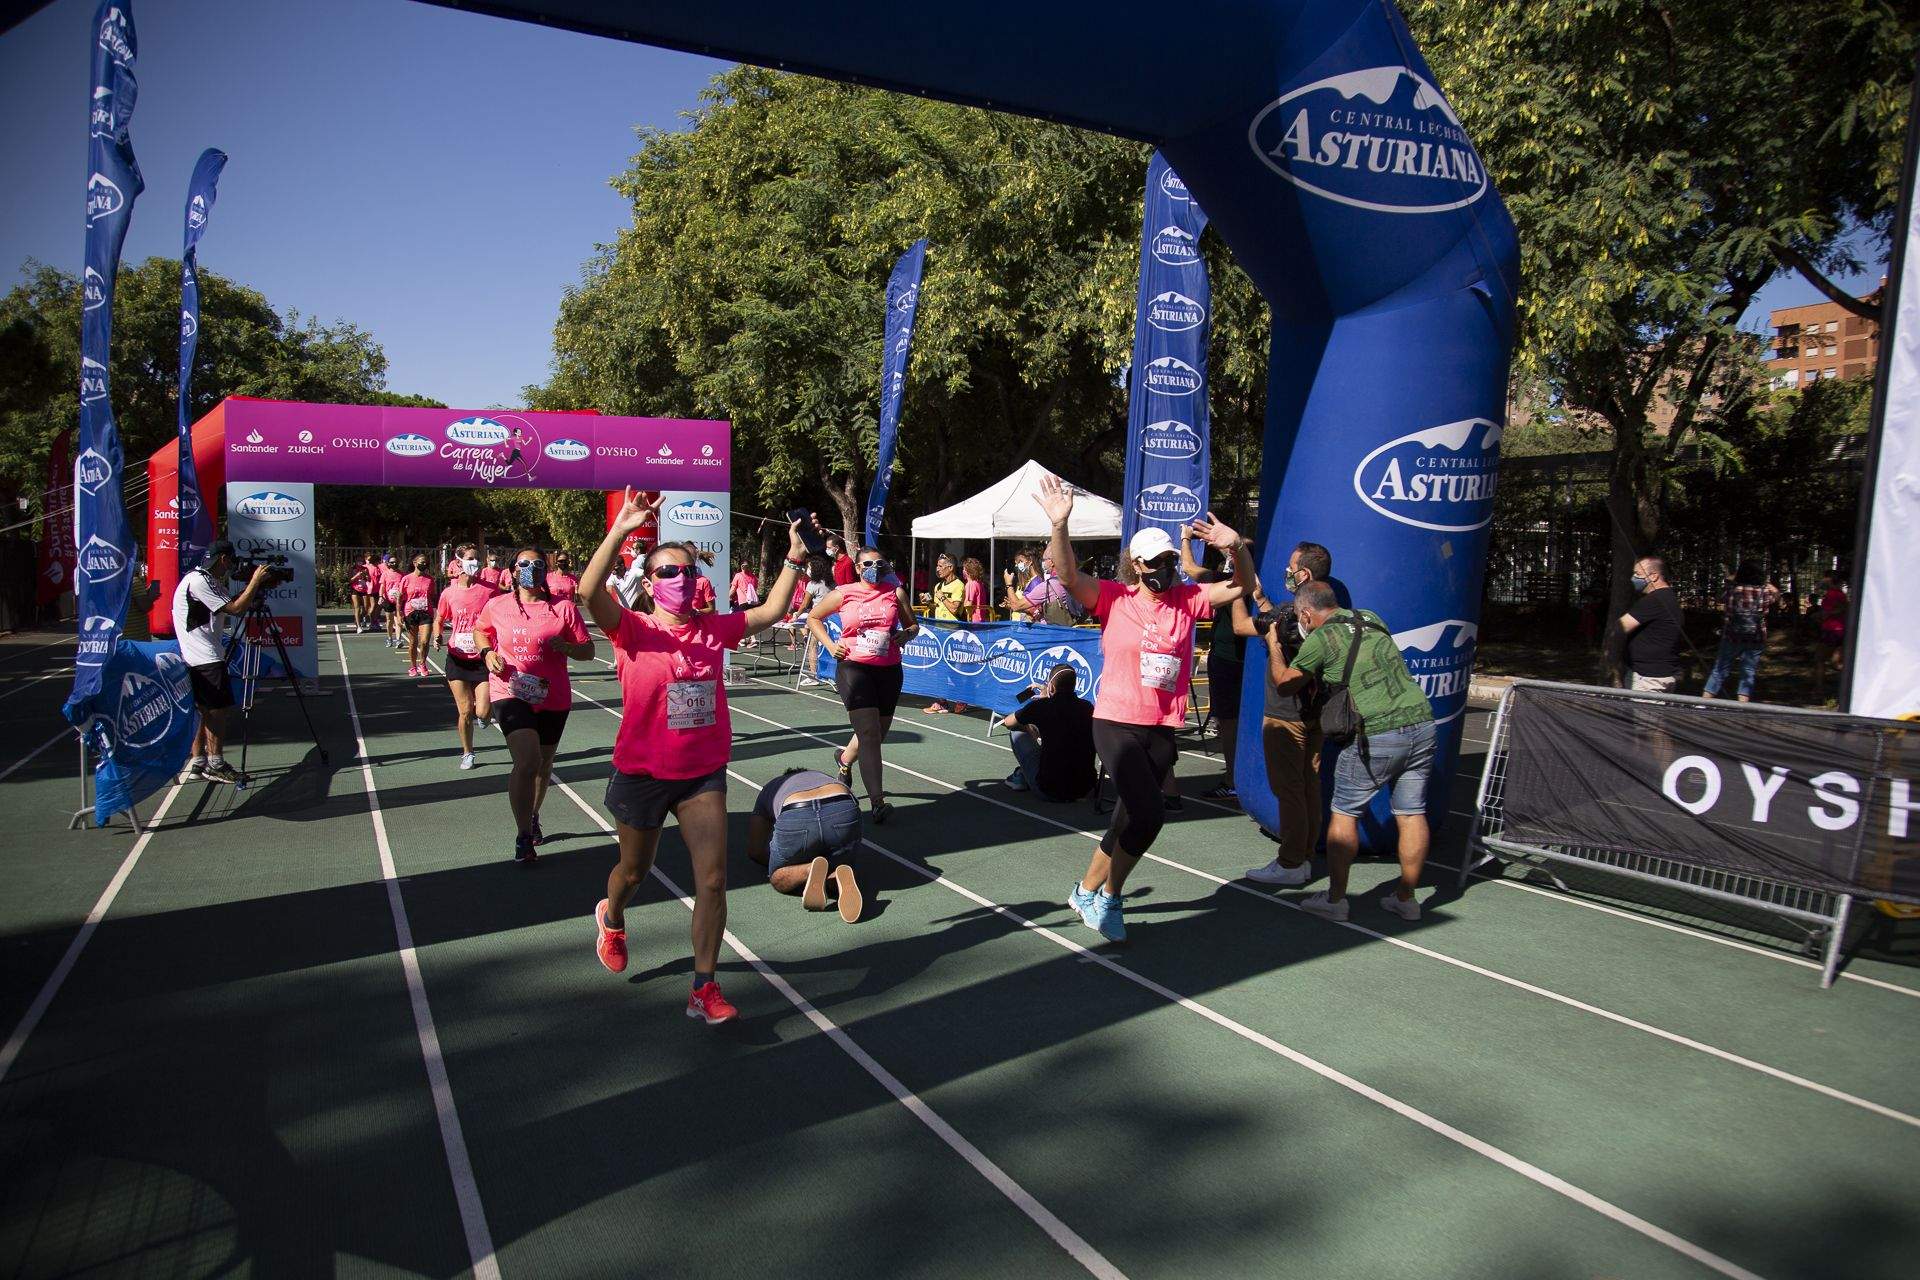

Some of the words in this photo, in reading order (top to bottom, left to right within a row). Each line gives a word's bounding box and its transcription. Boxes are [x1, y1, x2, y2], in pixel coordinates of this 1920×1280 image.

[1330, 109, 1412, 132] CENTRAL
[1269, 108, 1482, 185] ASTURIANA
[1144, 369, 1196, 389] ASTURIANA
[450, 426, 506, 440] ASTURIANA
[230, 443, 279, 453] Santander
[332, 437, 380, 449] OYSHO
[389, 442, 432, 452] ASTURIANA
[288, 445, 324, 454] ZURICH
[440, 442, 493, 460] Carrera
[548, 446, 588, 456] ASTURIANA
[596, 446, 638, 457] OYSHO
[645, 456, 685, 466] Santander
[692, 458, 722, 467] ZURICH
[1416, 456, 1479, 469] CENTRAL
[453, 460, 465, 471] de
[465, 462, 473, 471] la
[471, 458, 513, 483] Mujer
[241, 502, 301, 516] ASTURIANA
[672, 509, 721, 521] ASTURIANA
[237, 537, 306, 553] OYSHO
[264, 588, 298, 600] RICH
[512, 627, 527, 635] WE
[866, 637, 879, 645] 016
[900, 644, 940, 660] TURIANA
[1403, 656, 1451, 670] NTRAL
[1155, 666, 1172, 675] 016
[686, 697, 706, 708] 016
